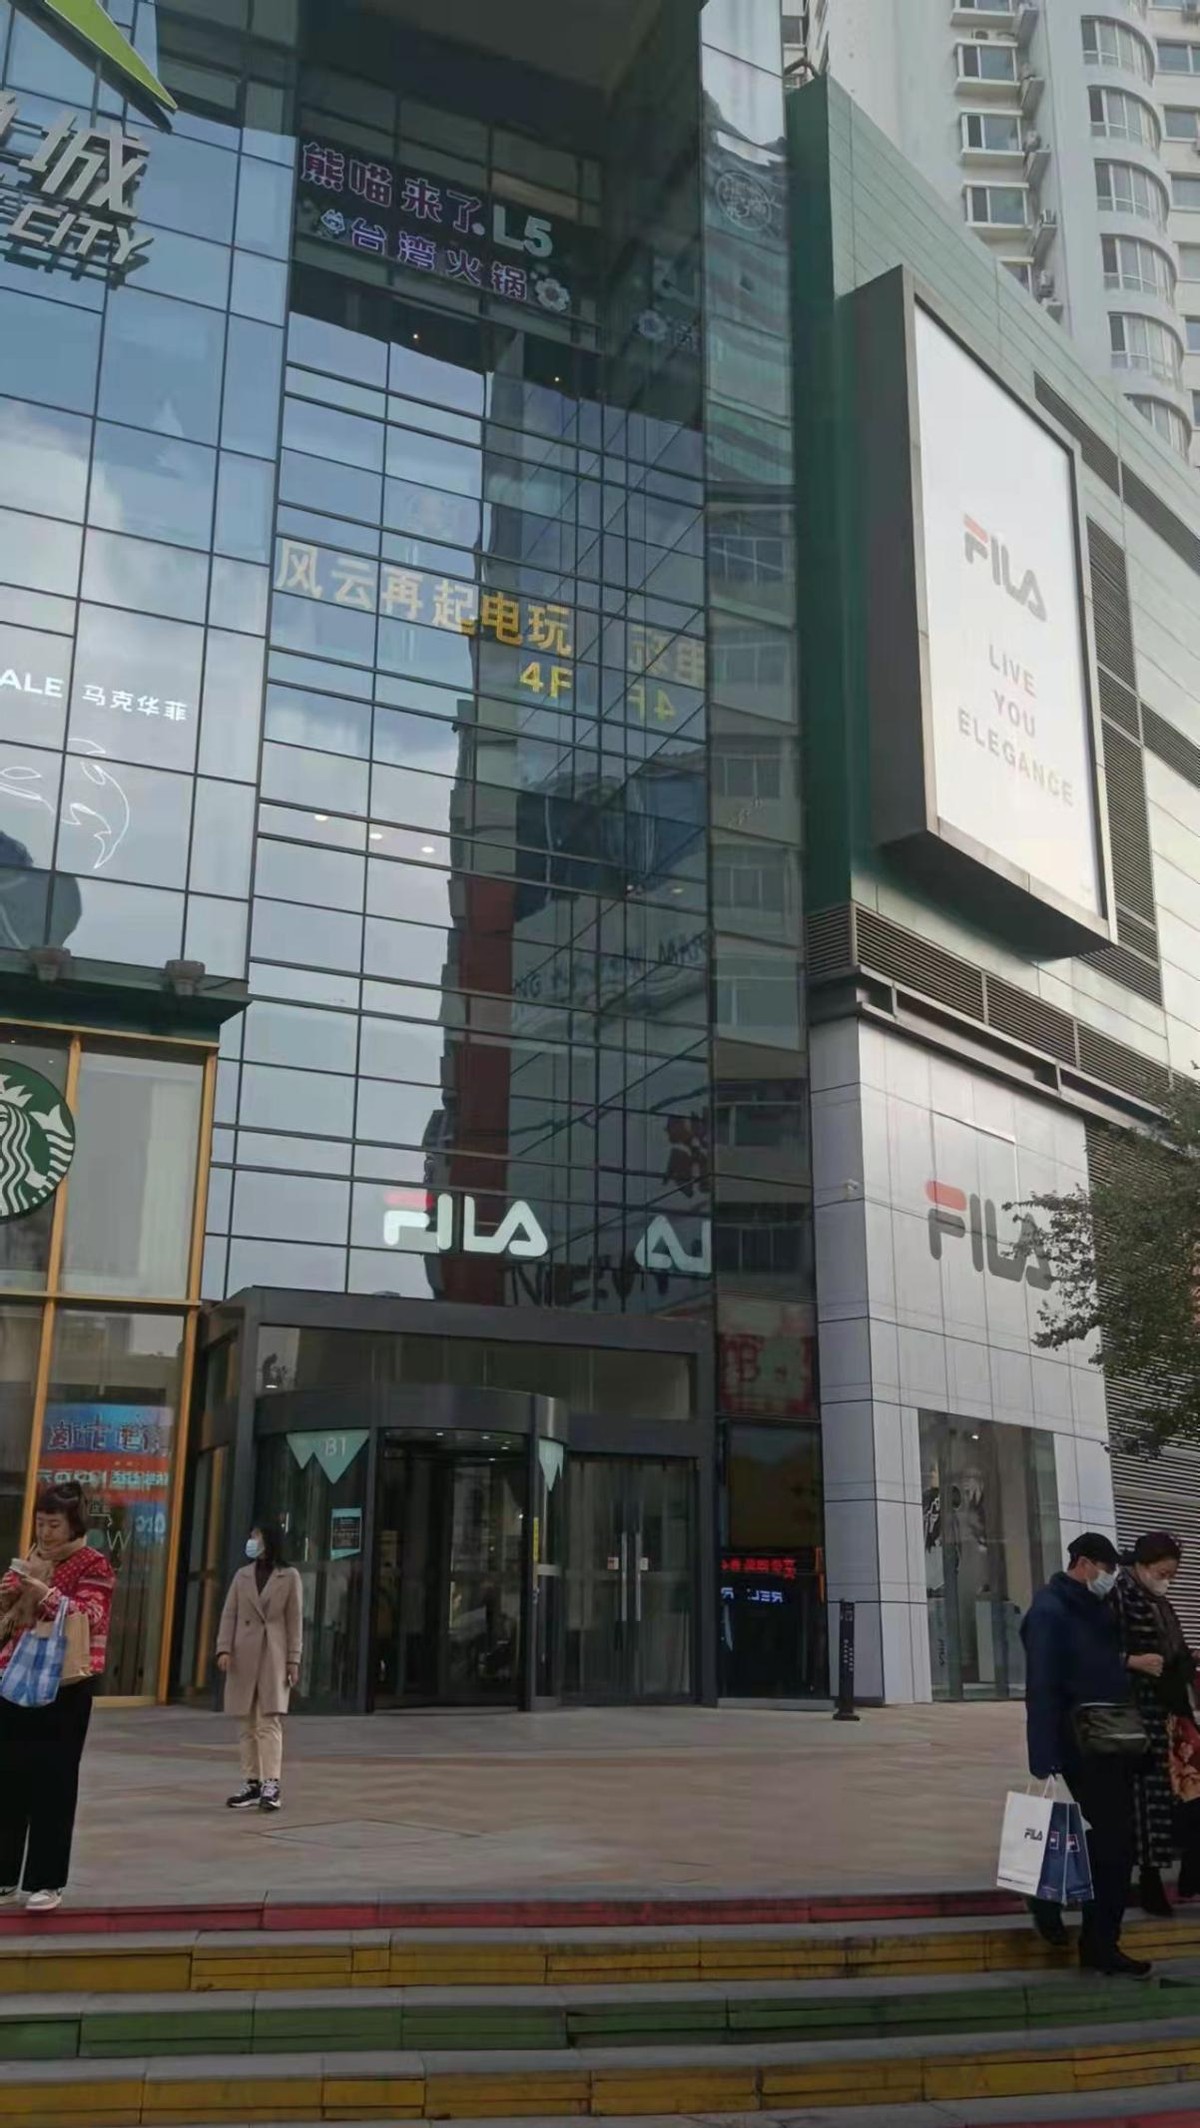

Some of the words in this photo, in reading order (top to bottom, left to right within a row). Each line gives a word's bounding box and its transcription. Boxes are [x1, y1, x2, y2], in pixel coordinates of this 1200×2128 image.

[0, 92, 151, 219] 城
[8, 203, 154, 265] CITY
[351, 217, 528, 301] 台湾火锅
[274, 540, 572, 656] 风云再起电玩
[963, 513, 1047, 622] FILA
[82, 684, 188, 722] 马克华菲
[519, 662, 573, 699] 4F
[988, 644, 1036, 698] LIVE
[993, 689, 1035, 738] YOU
[957, 707, 1073, 807] ELEGANCE
[383, 1192, 548, 1258] FILA
[925, 1180, 1051, 1291] FILA
